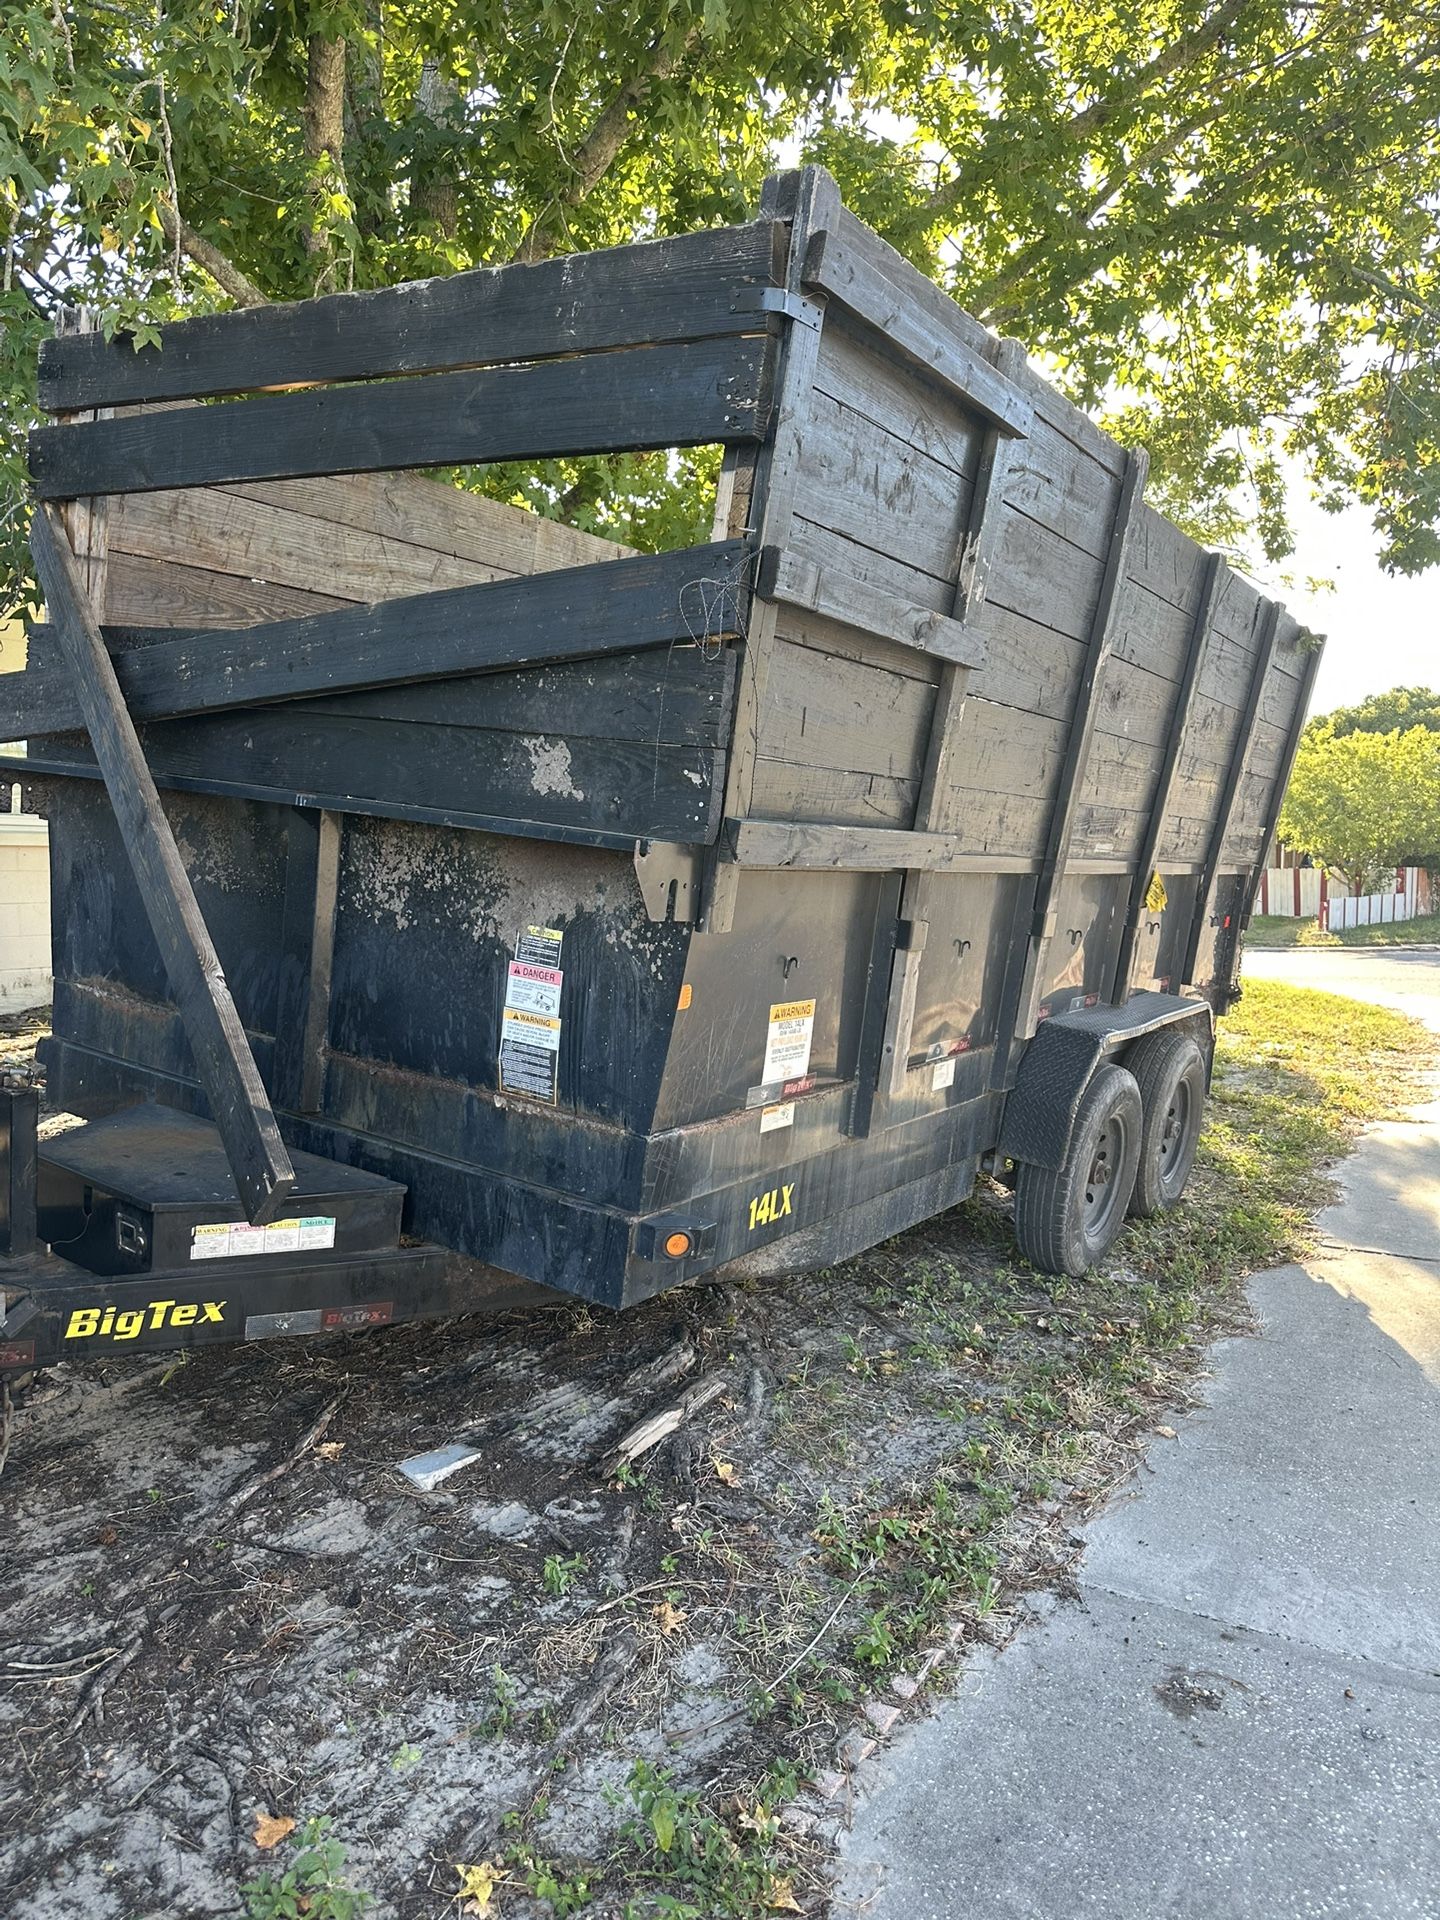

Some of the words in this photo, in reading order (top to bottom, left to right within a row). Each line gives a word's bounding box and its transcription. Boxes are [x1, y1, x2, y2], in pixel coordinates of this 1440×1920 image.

[523, 967, 555, 982] DANGER
[781, 1004, 811, 1018] WARNING
[520, 1013, 551, 1027] WARNING
[748, 1182, 795, 1231] 14LX
[64, 1300, 227, 1341] BigTex
